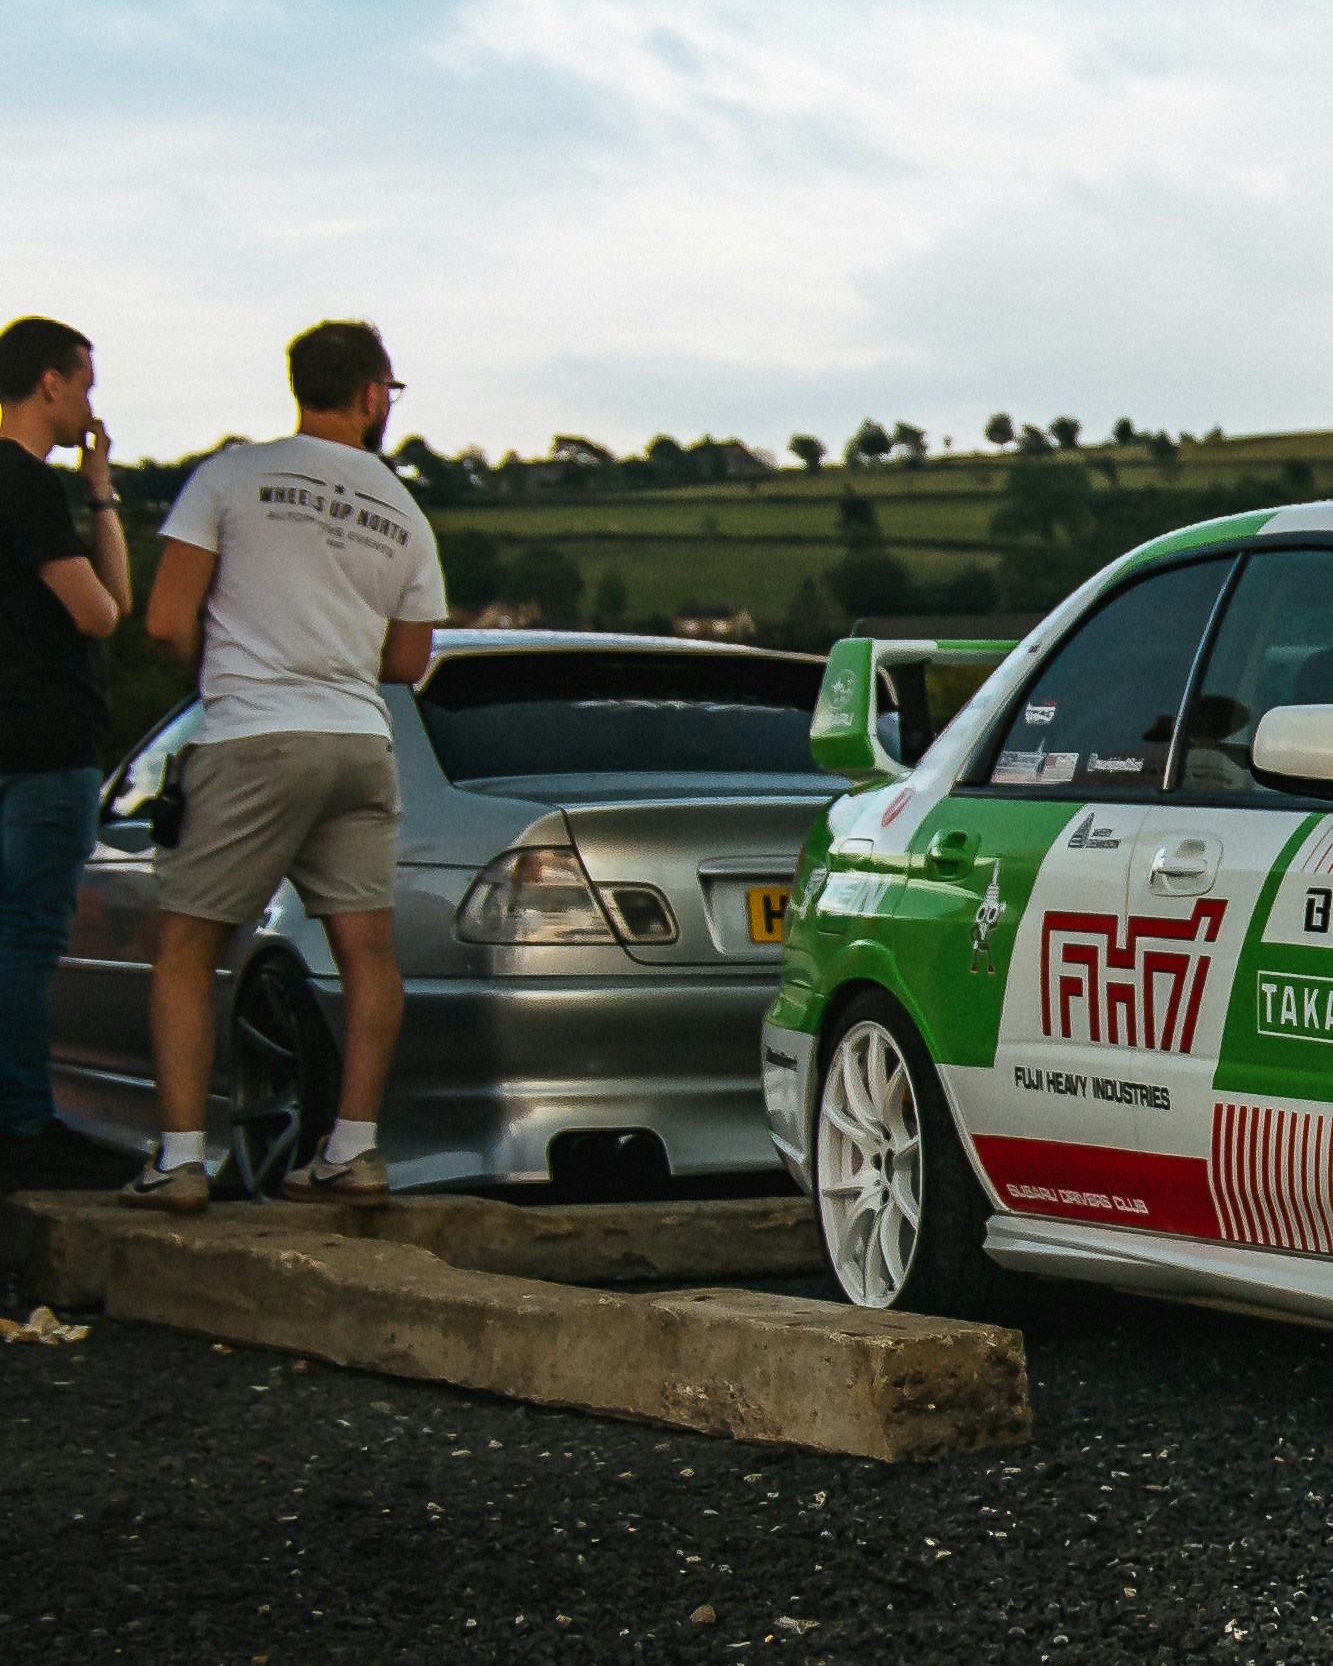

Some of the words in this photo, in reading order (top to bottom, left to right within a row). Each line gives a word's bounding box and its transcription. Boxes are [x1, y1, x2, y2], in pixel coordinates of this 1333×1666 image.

[258, 486, 326, 513] WHEES
[762, 892, 790, 935] H
[1014, 1065, 1044, 1092] FUJI
[1046, 1069, 1088, 1100] HEAVY
[1091, 1076, 1172, 1111] INDUSTRIES
